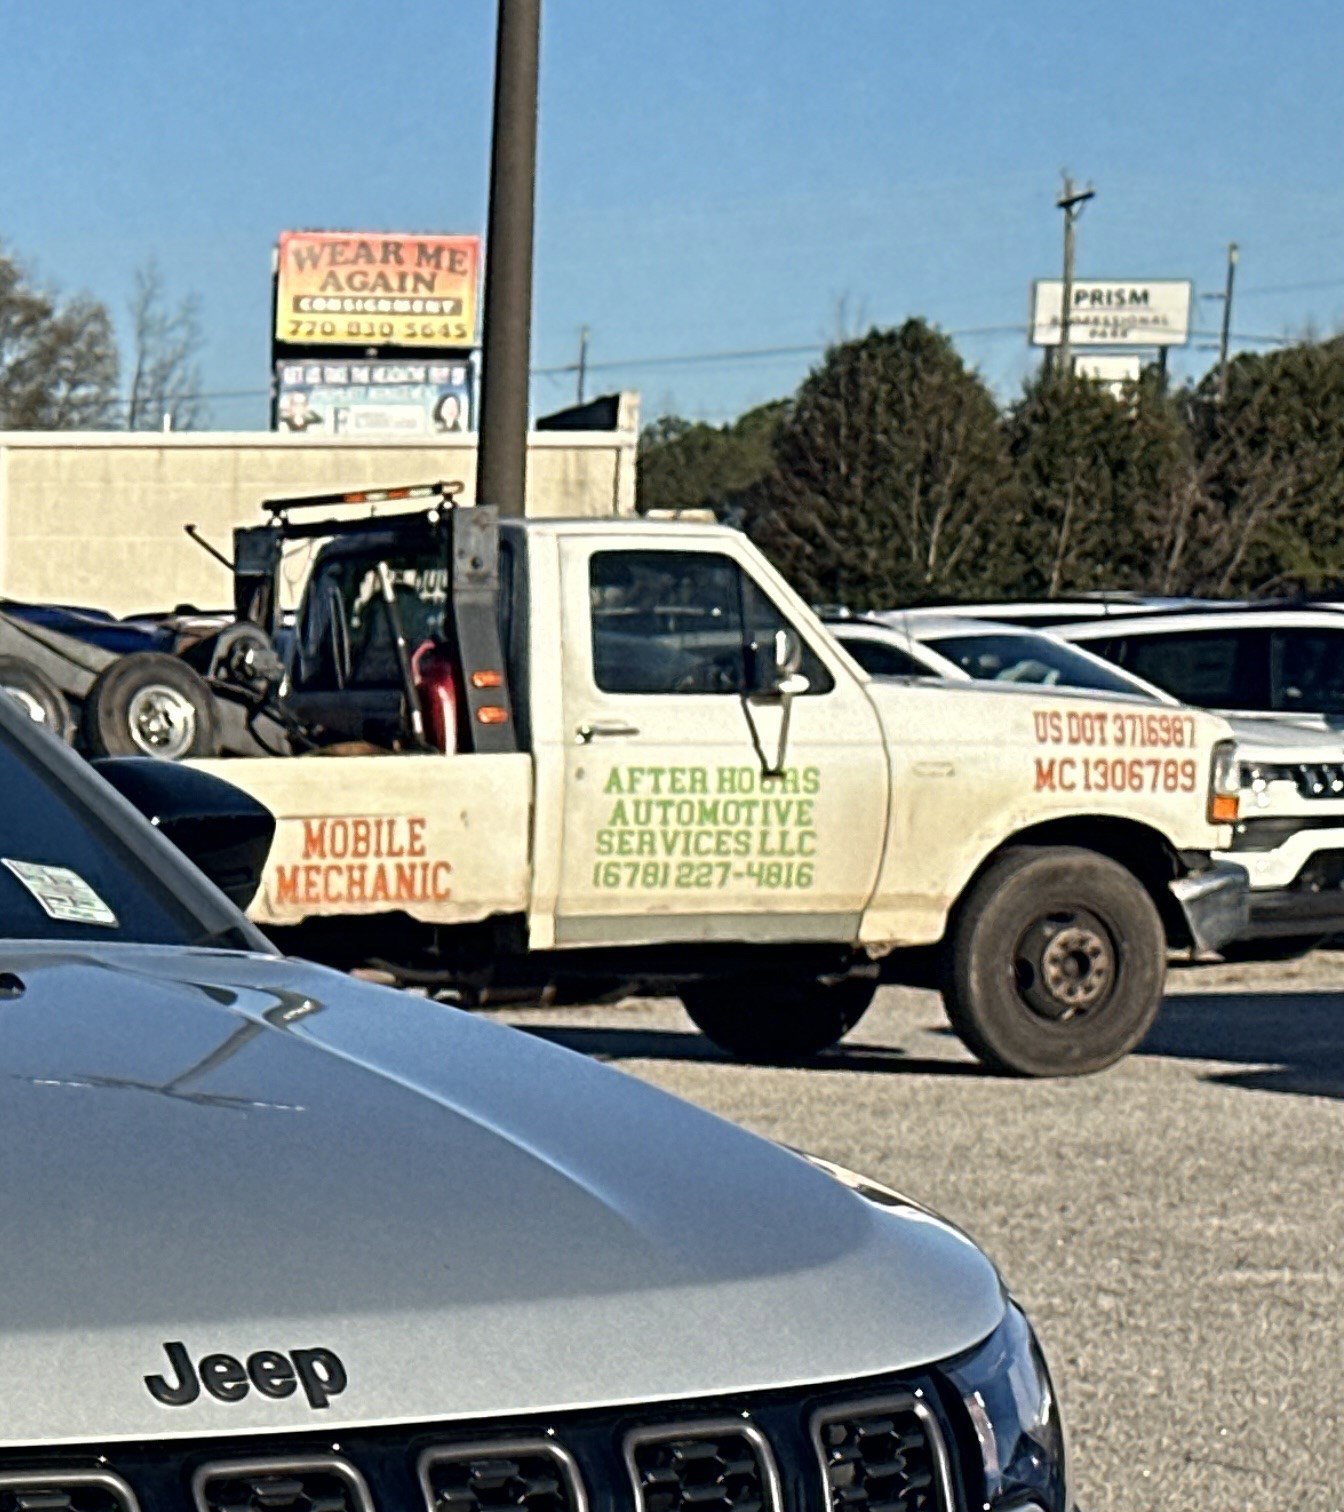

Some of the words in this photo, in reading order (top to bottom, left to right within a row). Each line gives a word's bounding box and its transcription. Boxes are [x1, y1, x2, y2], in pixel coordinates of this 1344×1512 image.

[291, 240, 403, 271] WEAR
[416, 241, 467, 275] ME
[319, 270, 436, 292] AGAIN
[1074, 288, 1148, 306] PRISM
[288, 319, 333, 336] 770
[1032, 710, 1061, 742] US
[1067, 711, 1106, 744] DOT
[1113, 713, 1195, 746] 3716987
[603, 766, 707, 793] AFTER
[1033, 757, 1075, 790] MC
[1083, 758, 1196, 791] 1306789
[608, 799, 813, 825] AUTOMOTIVE
[301, 817, 426, 858] MOBILE
[595, 829, 751, 855] SERVICES
[759, 829, 816, 855] LLC
[275, 861, 451, 903] MECHANIC
[674, 861, 812, 887] 227-4816
[143, 1341, 348, 1410] Jeep
